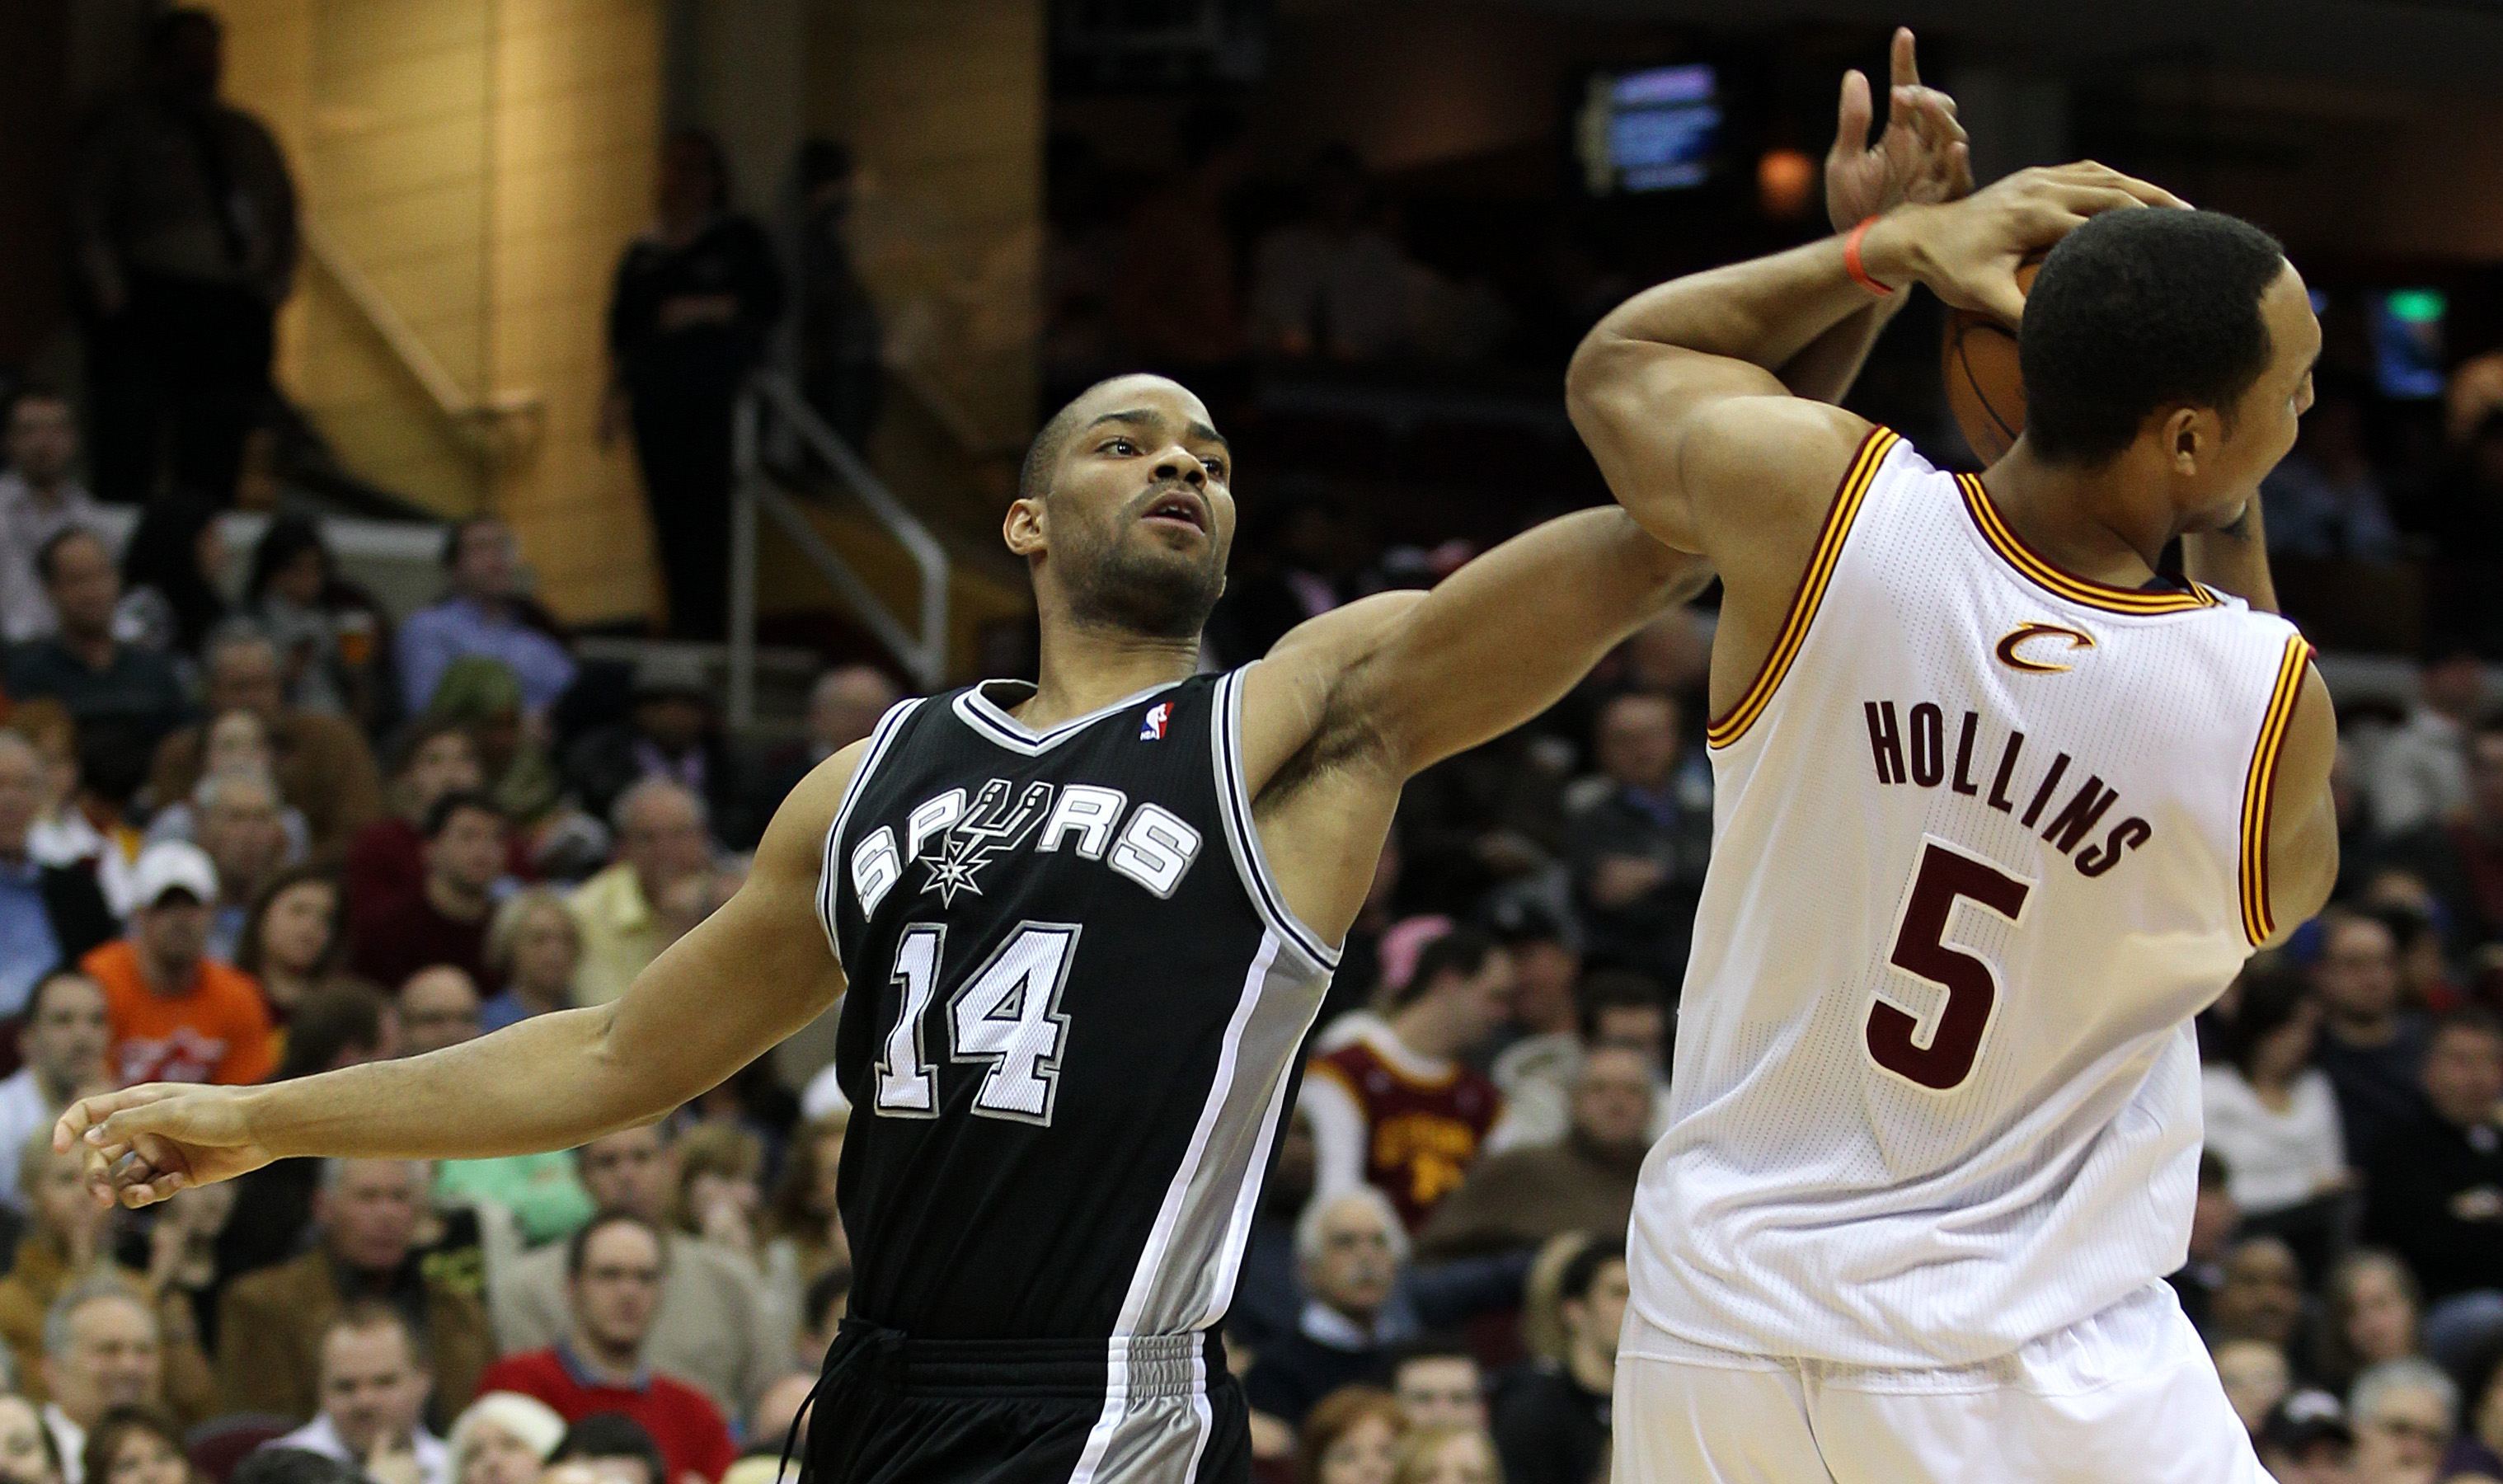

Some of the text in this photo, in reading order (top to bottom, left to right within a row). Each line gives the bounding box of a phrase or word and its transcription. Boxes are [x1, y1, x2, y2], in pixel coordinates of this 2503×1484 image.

[1140, 730, 1158, 740] NBA
[1864, 701, 2152, 878] HOLLINS
[851, 777, 1204, 923] SPURS
[874, 920, 1082, 1127] 14
[1862, 834, 2036, 1095] 5
